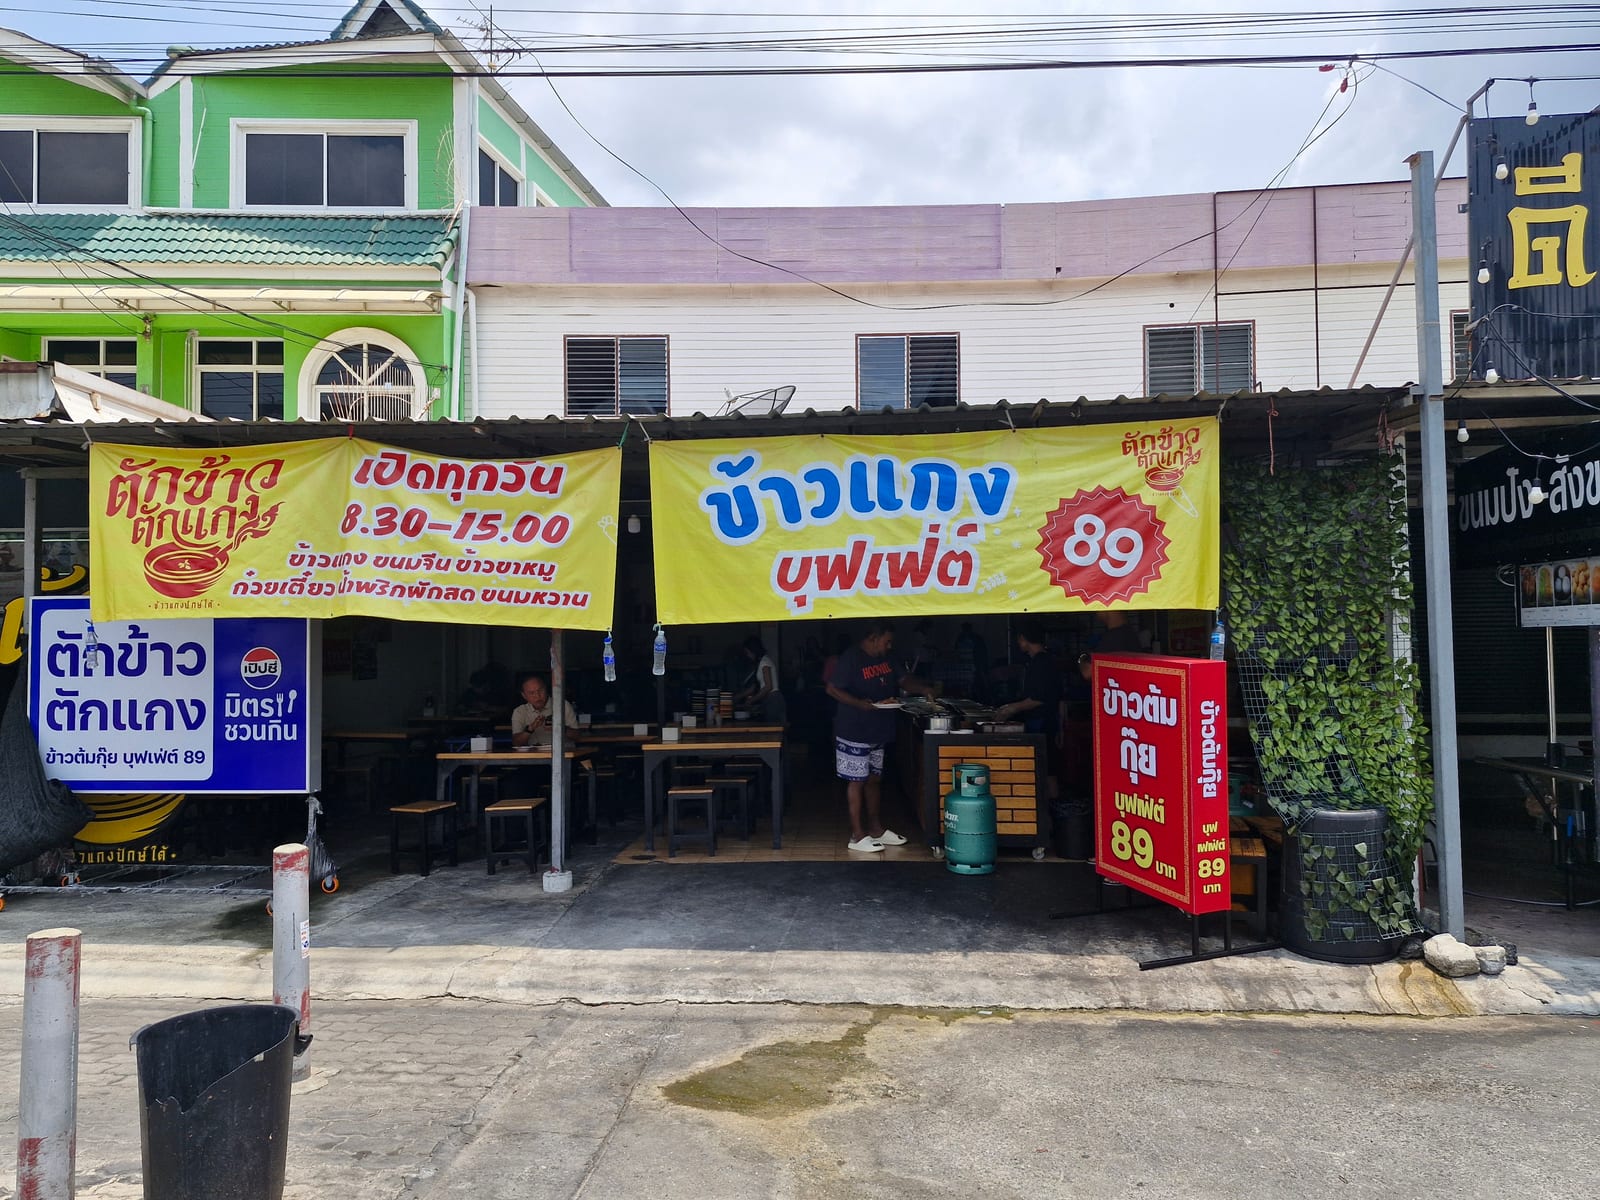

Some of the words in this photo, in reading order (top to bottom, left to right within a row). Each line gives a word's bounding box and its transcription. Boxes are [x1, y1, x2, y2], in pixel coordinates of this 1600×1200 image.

[1121, 425, 1200, 456] ตักข้าว
[106, 454, 285, 519] ตักข้าว
[354, 452, 563, 501] เปิดทุกวัน
[706, 455, 1010, 539] ข้าวแกง
[131, 494, 286, 550] ตักแกง
[1063, 514, 1144, 577] 89
[372, 553, 451, 572] ขนมจีน
[455, 548, 556, 582] ข้าวขาหมู
[776, 522, 979, 608] บุฟเฟ่ต์
[232, 570, 336, 597] ก๋วยเตี๋ยว
[481, 588, 588, 608] ขนมหวาน
[46, 624, 207, 678] ตักข้าว
[46, 687, 207, 732] ตักแกง
[224, 692, 275, 718] มิตร
[1102, 677, 1177, 727] ข้าวต้ม
[224, 719, 298, 741] ชวนกิน
[1197, 700, 1222, 798] ข้าวต้มกุ๊ย
[45, 746, 118, 769] ข้าวต้มกุ๊ย
[123, 747, 179, 769] บุฟเฟ่ต์
[184, 750, 206, 764] 89
[1120, 726, 1157, 785] กุ๊ย
[1114, 791, 1165, 825] บุฟเฟ่ต์
[1202, 821, 1218, 837] บุฟ
[1111, 820, 1154, 869] 89
[1155, 860, 1177, 881] บาท
[1198, 857, 1226, 878] 89
[1203, 883, 1221, 894] บาท
